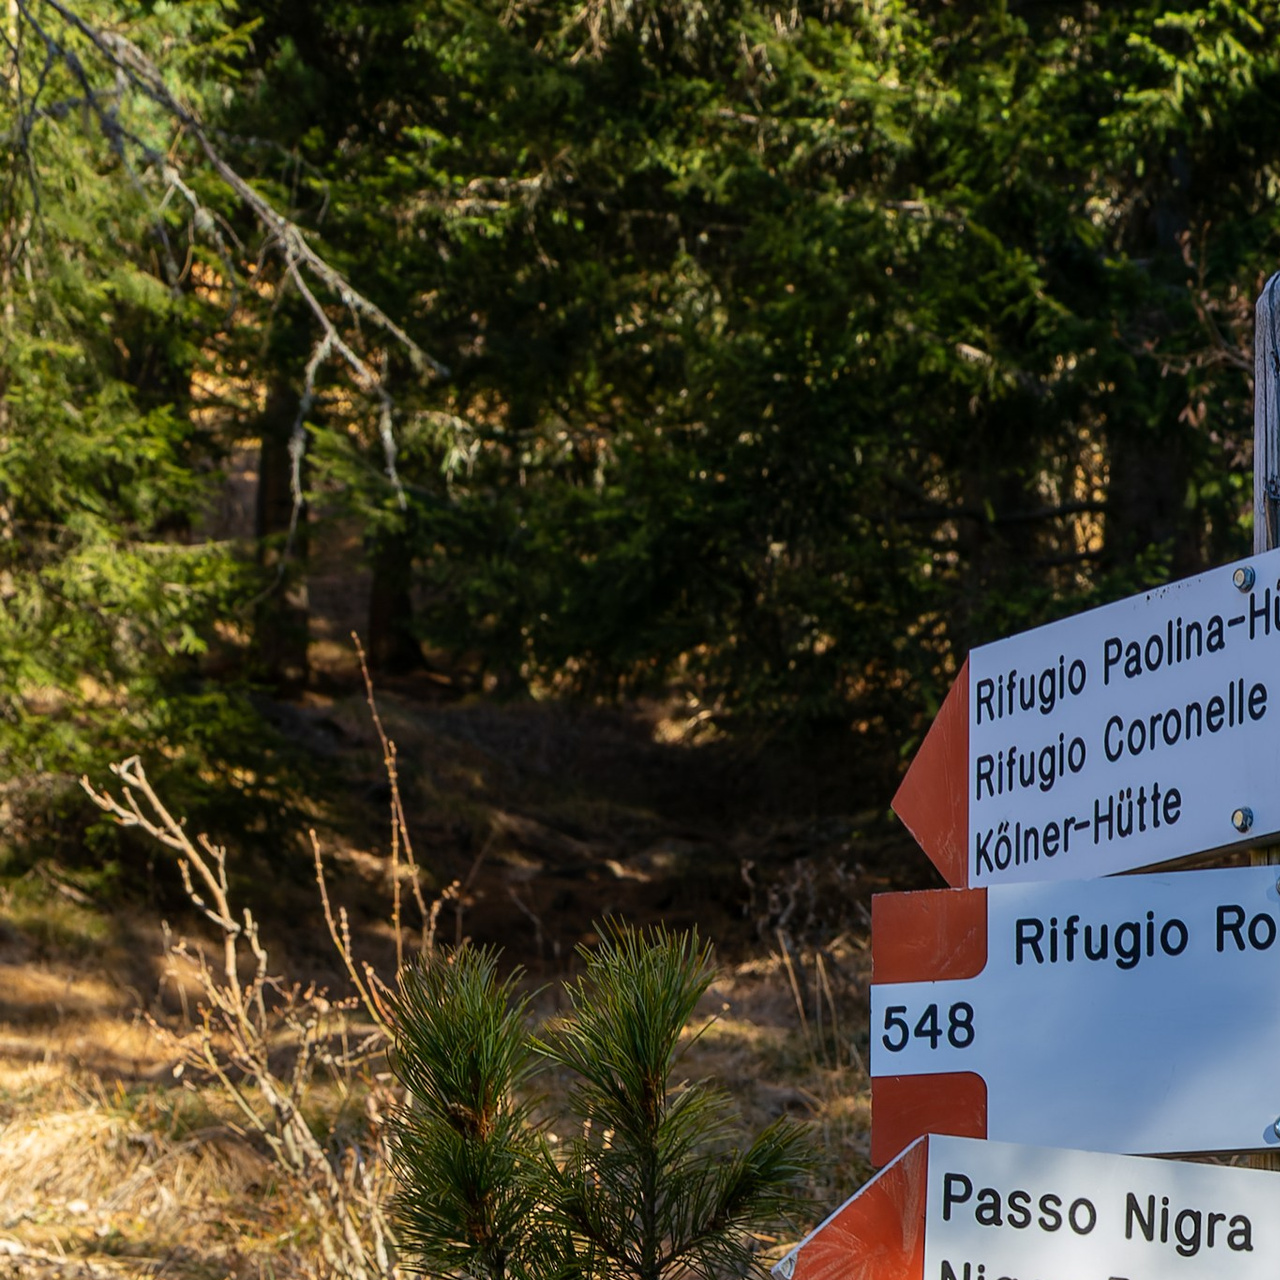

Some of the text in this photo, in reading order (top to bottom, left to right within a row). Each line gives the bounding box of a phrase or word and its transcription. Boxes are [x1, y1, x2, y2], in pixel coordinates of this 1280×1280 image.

[976, 654, 1087, 726] Rifugio
[976, 679, 1268, 802] Rifugio Coronelle
[1015, 910, 1189, 971] Rifugio
[881, 1001, 976, 1053] 548
[942, 1172, 1097, 1236] Passo
[1125, 1192, 1254, 1258] Nigra
